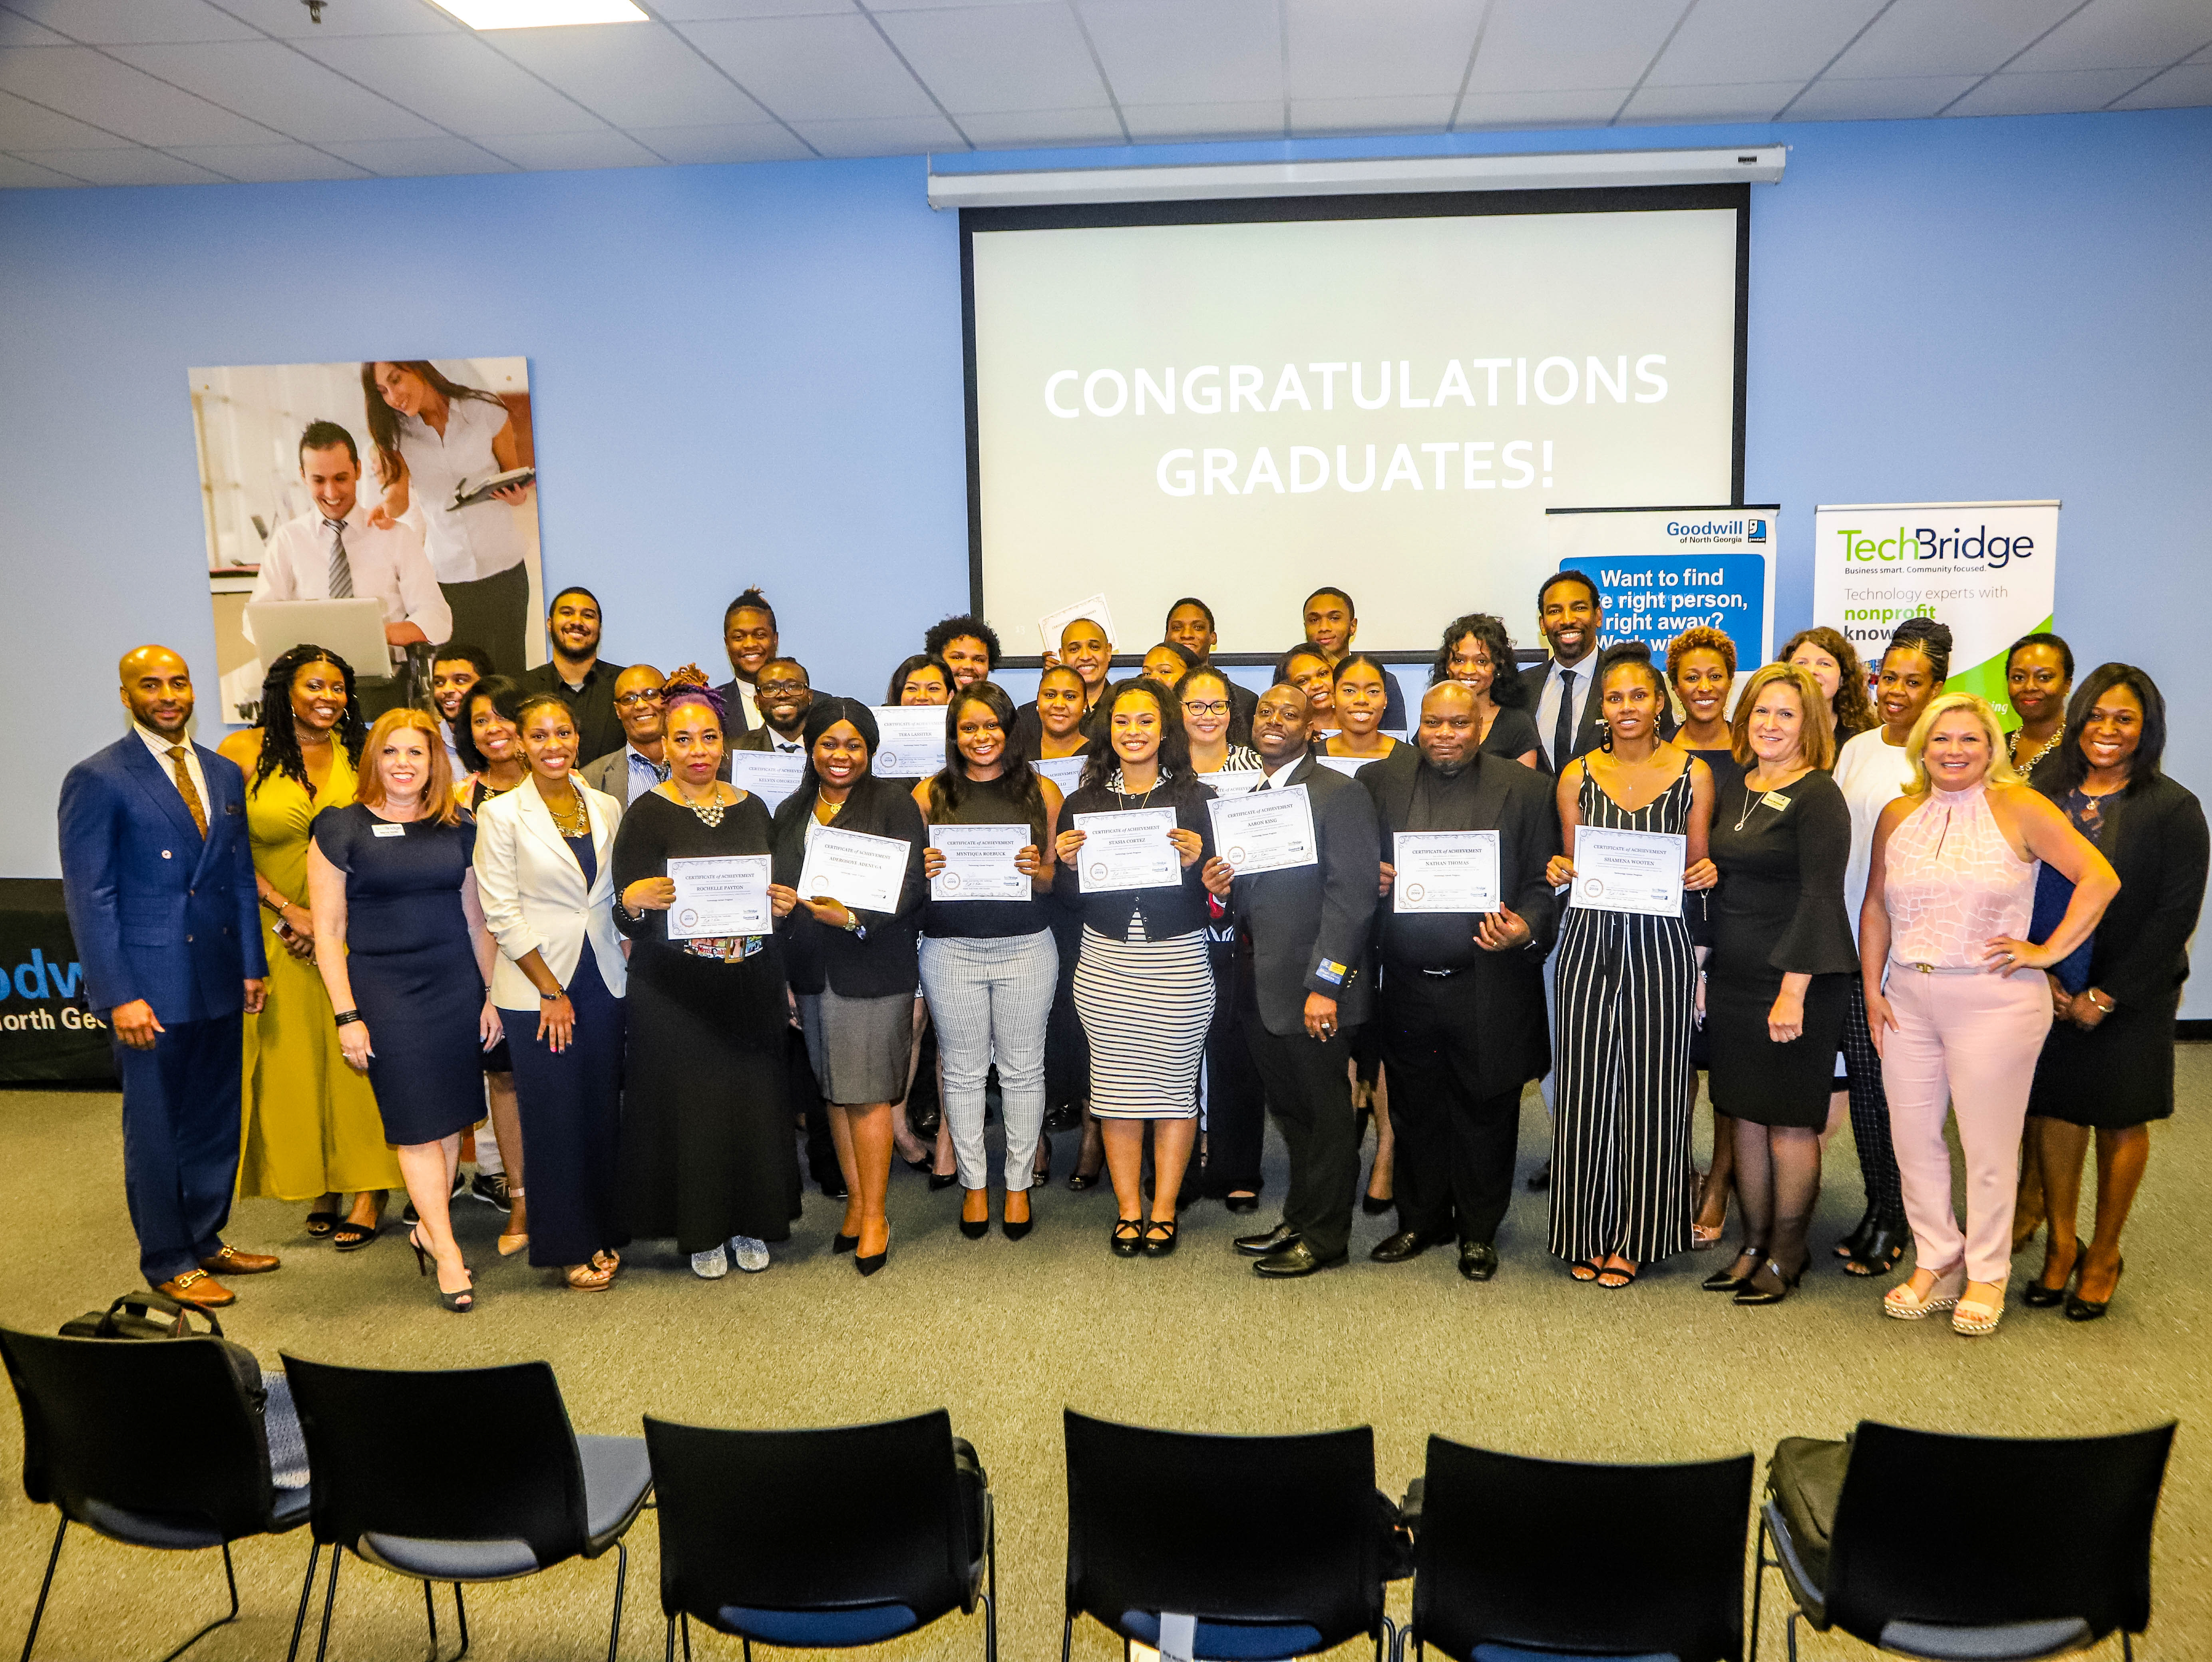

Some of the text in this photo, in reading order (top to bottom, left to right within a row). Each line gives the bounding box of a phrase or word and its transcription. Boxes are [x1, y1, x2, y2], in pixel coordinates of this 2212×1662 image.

[1044, 354, 1669, 418] CONGRATULATIONS
[1156, 440, 1554, 497] GRADUATES!
[1667, 521, 1743, 536] Goodwill
[1837, 525, 2034, 569] TechBridge
[1601, 568, 1724, 587] Want to find
[1907, 565, 1951, 574] Community
[1619, 592, 1666, 613] right
[1671, 593, 1748, 612] person,
[1844, 586, 2008, 603] Technology experts with
[1605, 612, 1653, 635] right
[1844, 604, 1936, 624] nonprofit
[1261, 804, 1293, 813] ACHIEVEMENT
[825, 844, 853, 853] CERTIFICATE
[859, 850, 891, 859] ACHIEVEMENT
[0, 1008, 56, 1031] orth
